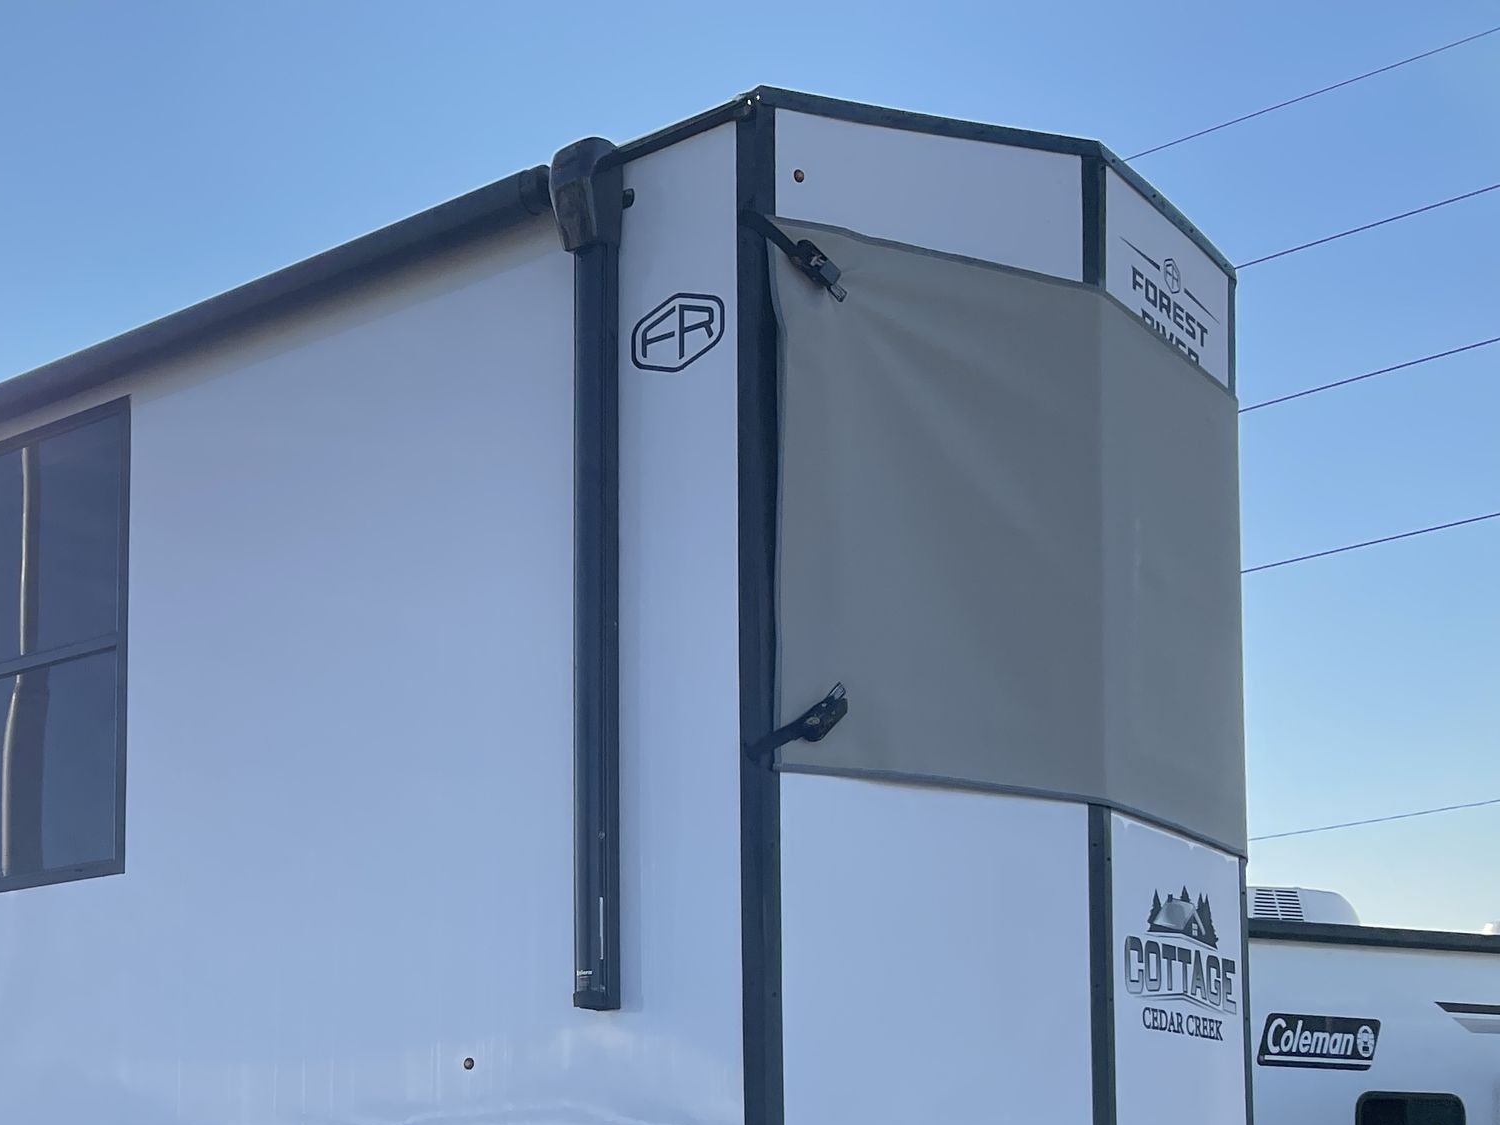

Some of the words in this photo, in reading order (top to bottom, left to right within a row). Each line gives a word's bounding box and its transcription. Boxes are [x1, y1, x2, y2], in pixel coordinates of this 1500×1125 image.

[1131, 265, 1208, 347] FOREST
[1124, 935, 1237, 1015] COTTAGE
[1142, 1007, 1184, 1034] CEDAR
[1186, 1015, 1223, 1041] CREEK
[1267, 1018, 1354, 1055] Coleman
